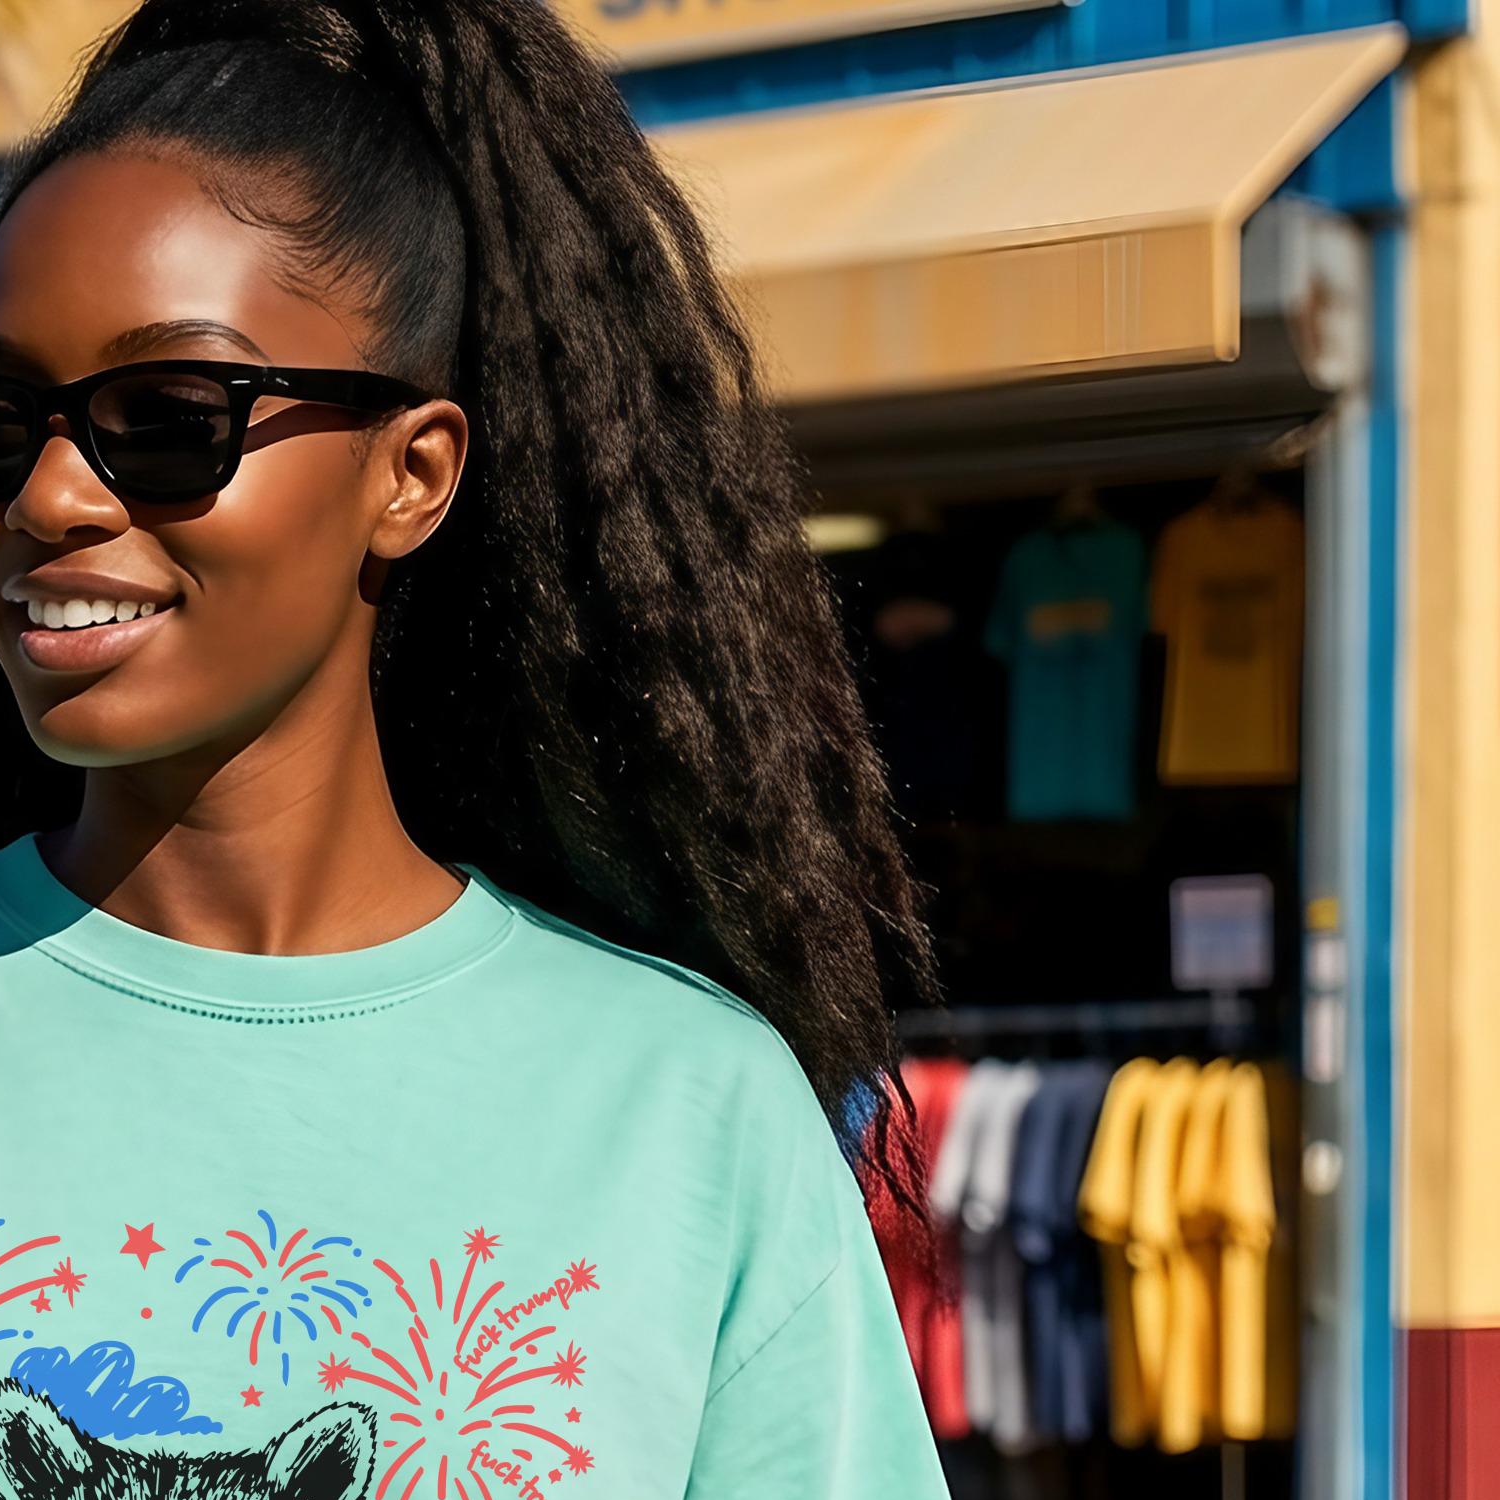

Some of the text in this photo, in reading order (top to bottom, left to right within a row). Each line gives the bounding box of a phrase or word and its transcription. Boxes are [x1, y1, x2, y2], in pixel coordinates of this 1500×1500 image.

[454, 1278, 571, 1379] fuck trump
[468, 1440, 528, 1492] fuck
